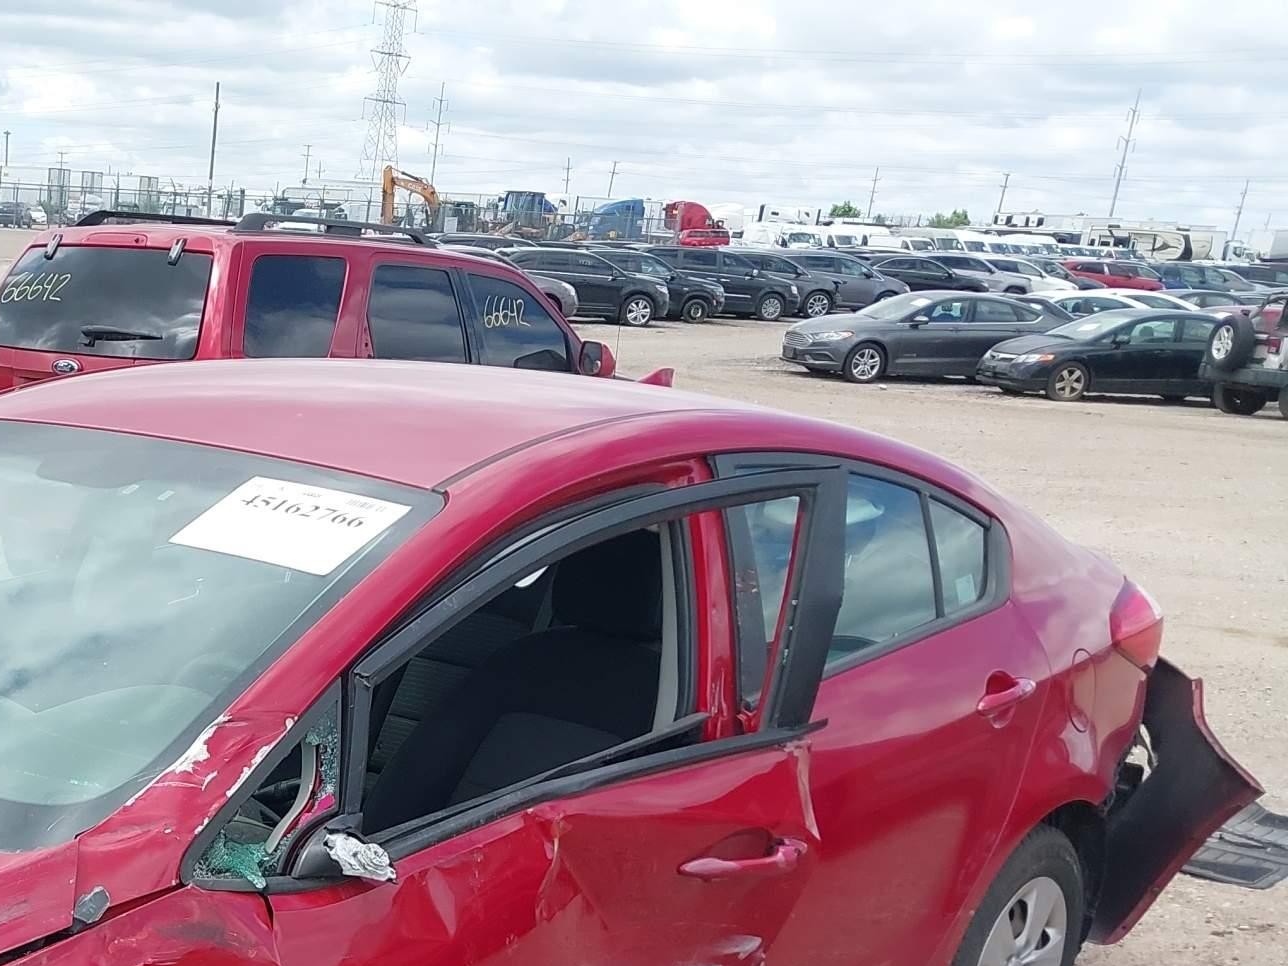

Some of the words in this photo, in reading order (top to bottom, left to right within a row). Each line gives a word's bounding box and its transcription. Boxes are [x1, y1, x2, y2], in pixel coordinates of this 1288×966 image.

[1, 271, 72, 304] 66642
[483, 295, 532, 329] 66642
[241, 494, 364, 528] 45162766
